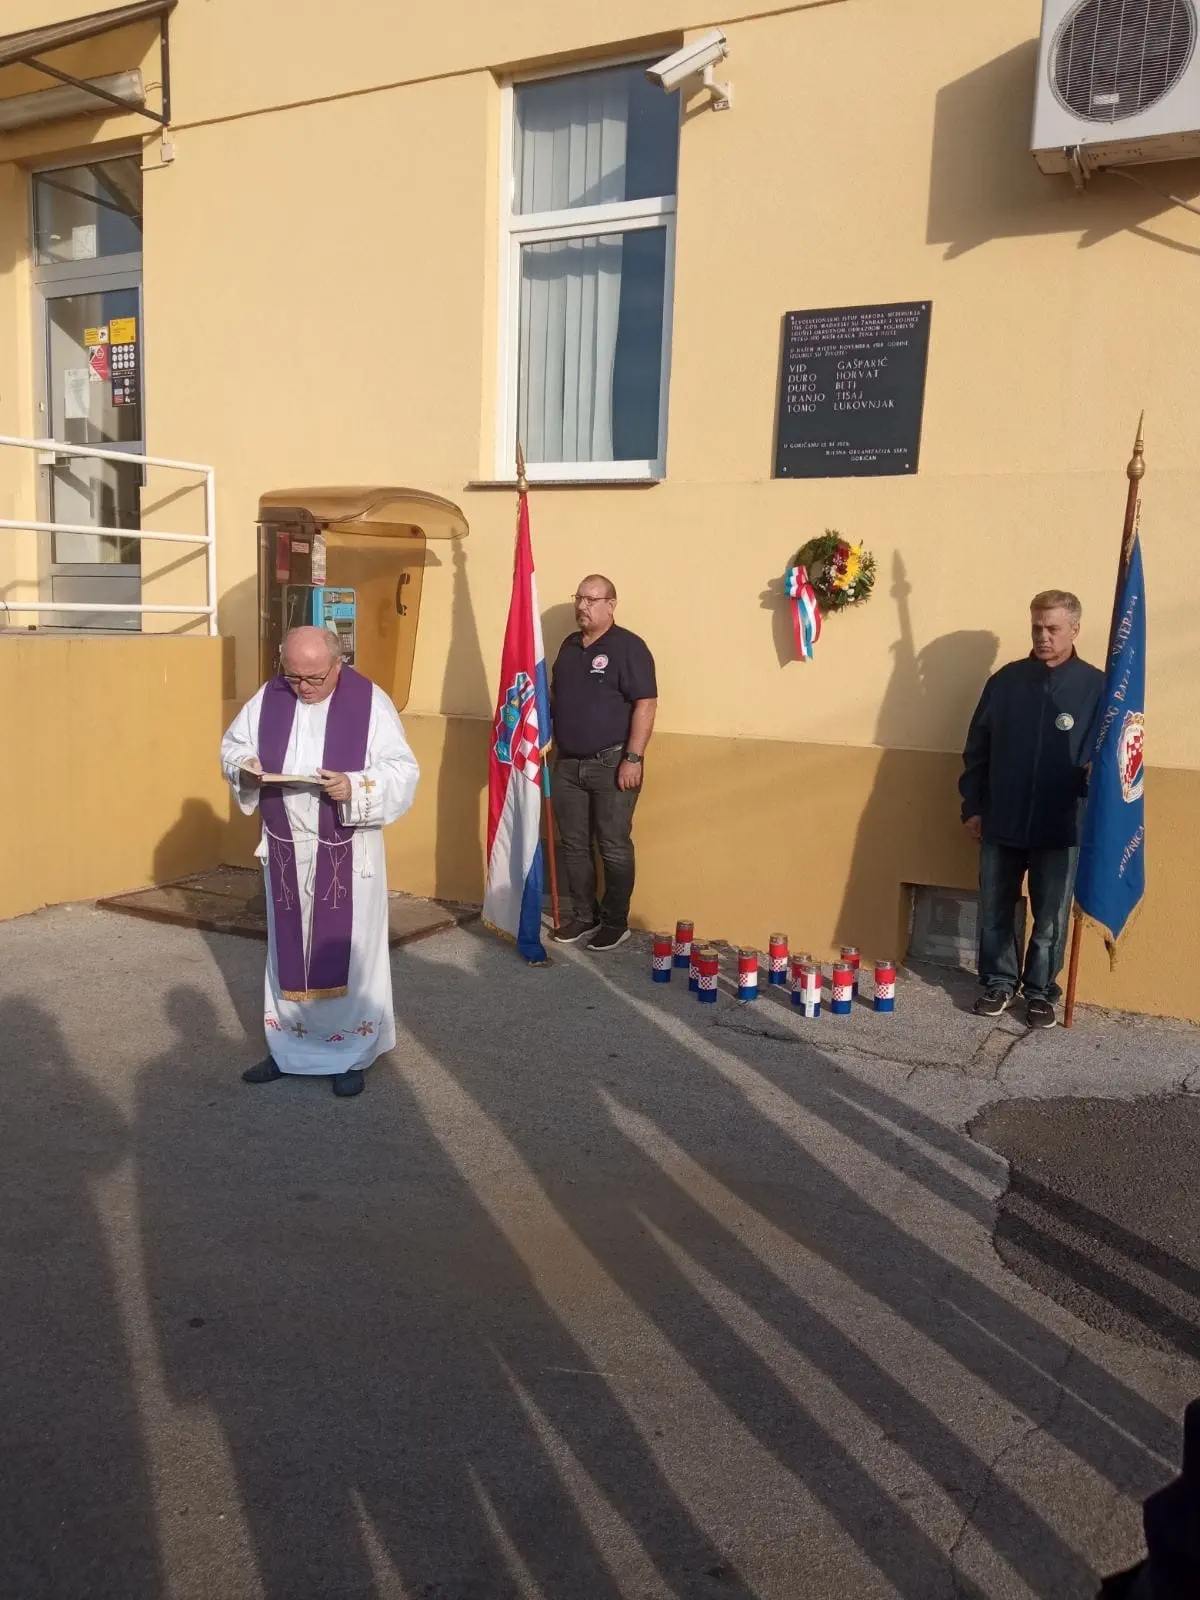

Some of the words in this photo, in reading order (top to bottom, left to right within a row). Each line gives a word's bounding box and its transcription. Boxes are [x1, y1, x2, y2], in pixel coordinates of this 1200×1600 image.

[789, 363, 807, 373] VID
[837, 356, 889, 370] GAŠPARIĆ
[836, 369, 881, 380] HORVAT
[787, 392, 826, 404] FRANJO
[788, 403, 817, 413] TOMO
[833, 399, 895, 411] LUKOVNJAK
